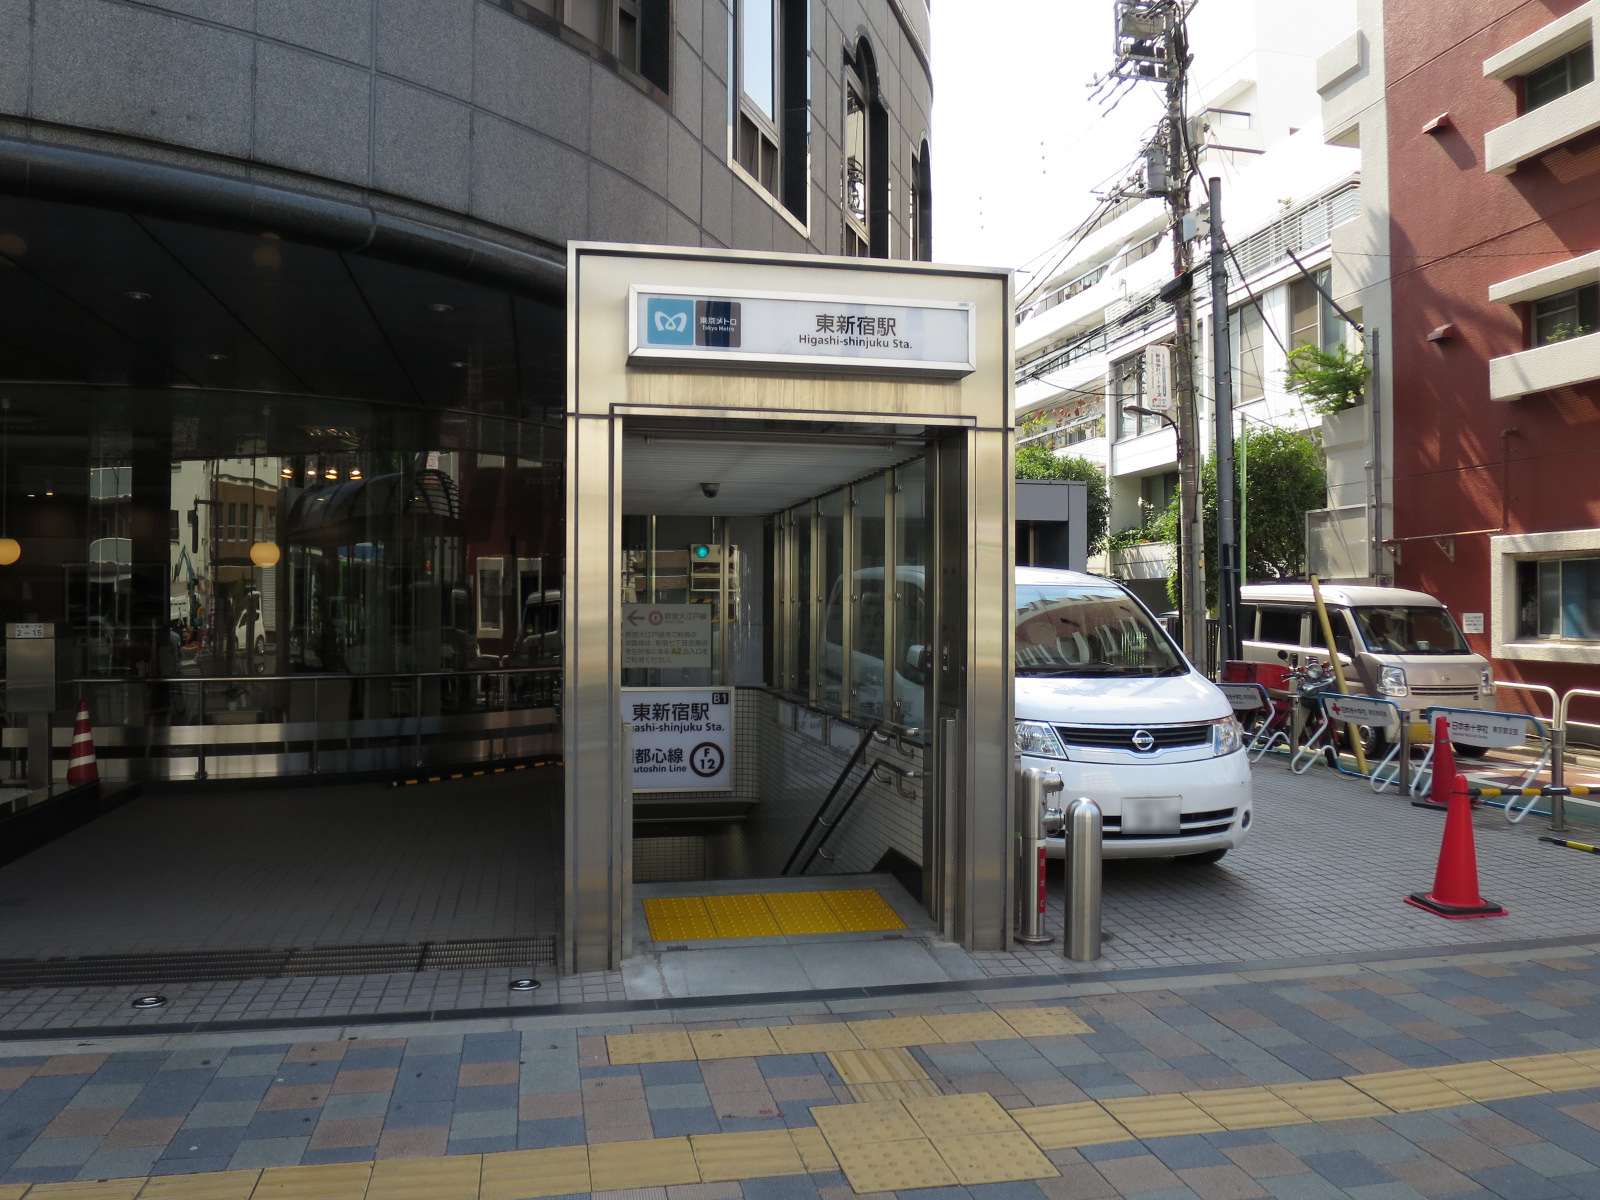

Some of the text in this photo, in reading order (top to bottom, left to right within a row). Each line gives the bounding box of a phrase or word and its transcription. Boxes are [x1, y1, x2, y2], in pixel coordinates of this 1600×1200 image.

[699, 316, 737, 326] 東京メトロ
[815, 313, 897, 337] 東新宿駅
[798, 334, 913, 350] Higashi-shinjuku Sta.
[713, 693, 728, 704] B1
[632, 702, 710, 722] 東新宿駅
[632, 723, 725, 734] ashi-shinjuku Sta.
[1452, 721, 1489, 734] 日本赤十字社
[632, 748, 684, 764] 都心線
[704, 748, 710, 758] F
[632, 764, 687, 773] utoshin Line
[700, 758, 715, 770] 12
